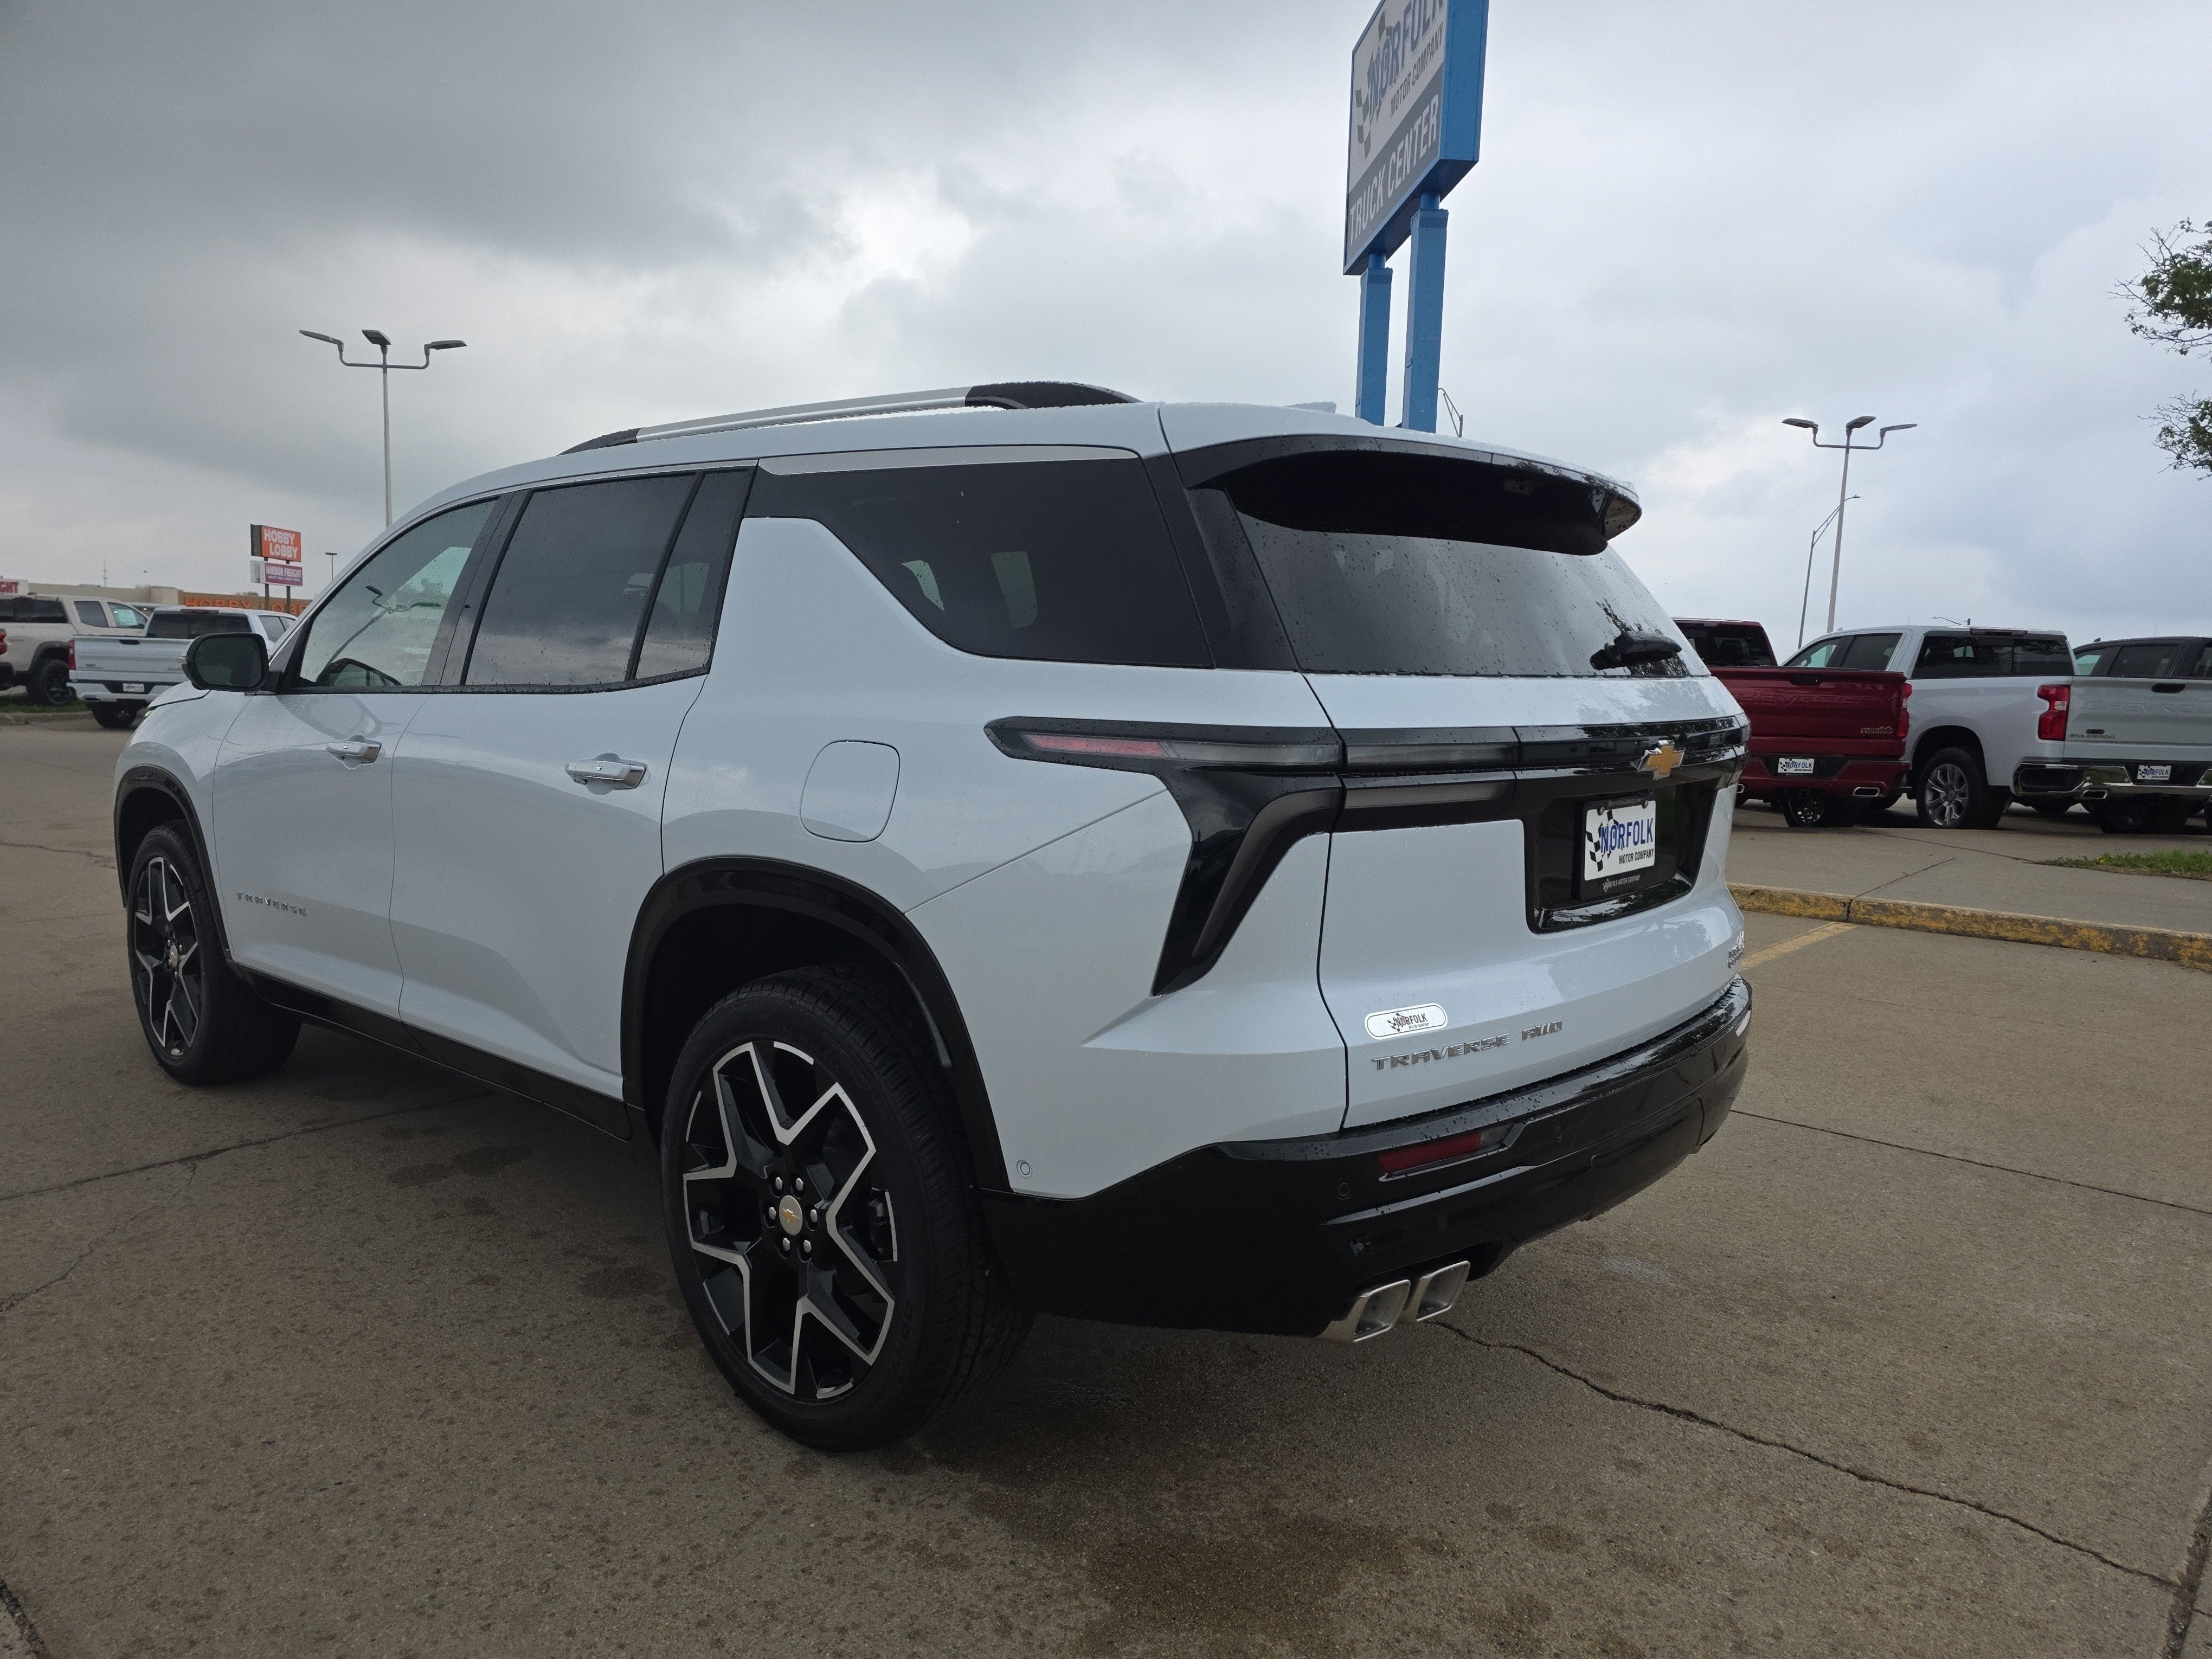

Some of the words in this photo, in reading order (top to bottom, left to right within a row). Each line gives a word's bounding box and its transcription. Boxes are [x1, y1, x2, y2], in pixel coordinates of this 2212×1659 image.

[1390, 71, 1411, 118] MOTOR
[1412, 20, 1443, 86] COMPANY
[1350, 168, 1385, 247] TRUCK
[1387, 94, 1439, 199] CENTER
[263, 528, 295, 545] HOBBY
[269, 542, 298, 558] LOBBY
[1601, 818, 1654, 853] NORFOLK
[1619, 852, 1634, 865] MOTOR
[1635, 848, 1654, 861] COMPANY
[235, 892, 307, 916] TRAVERSE
[1395, 1013, 1428, 1027] NORFOLK
[1371, 1033, 1510, 1070] TRAVERSE
[1521, 1020, 1562, 1040] AWD
